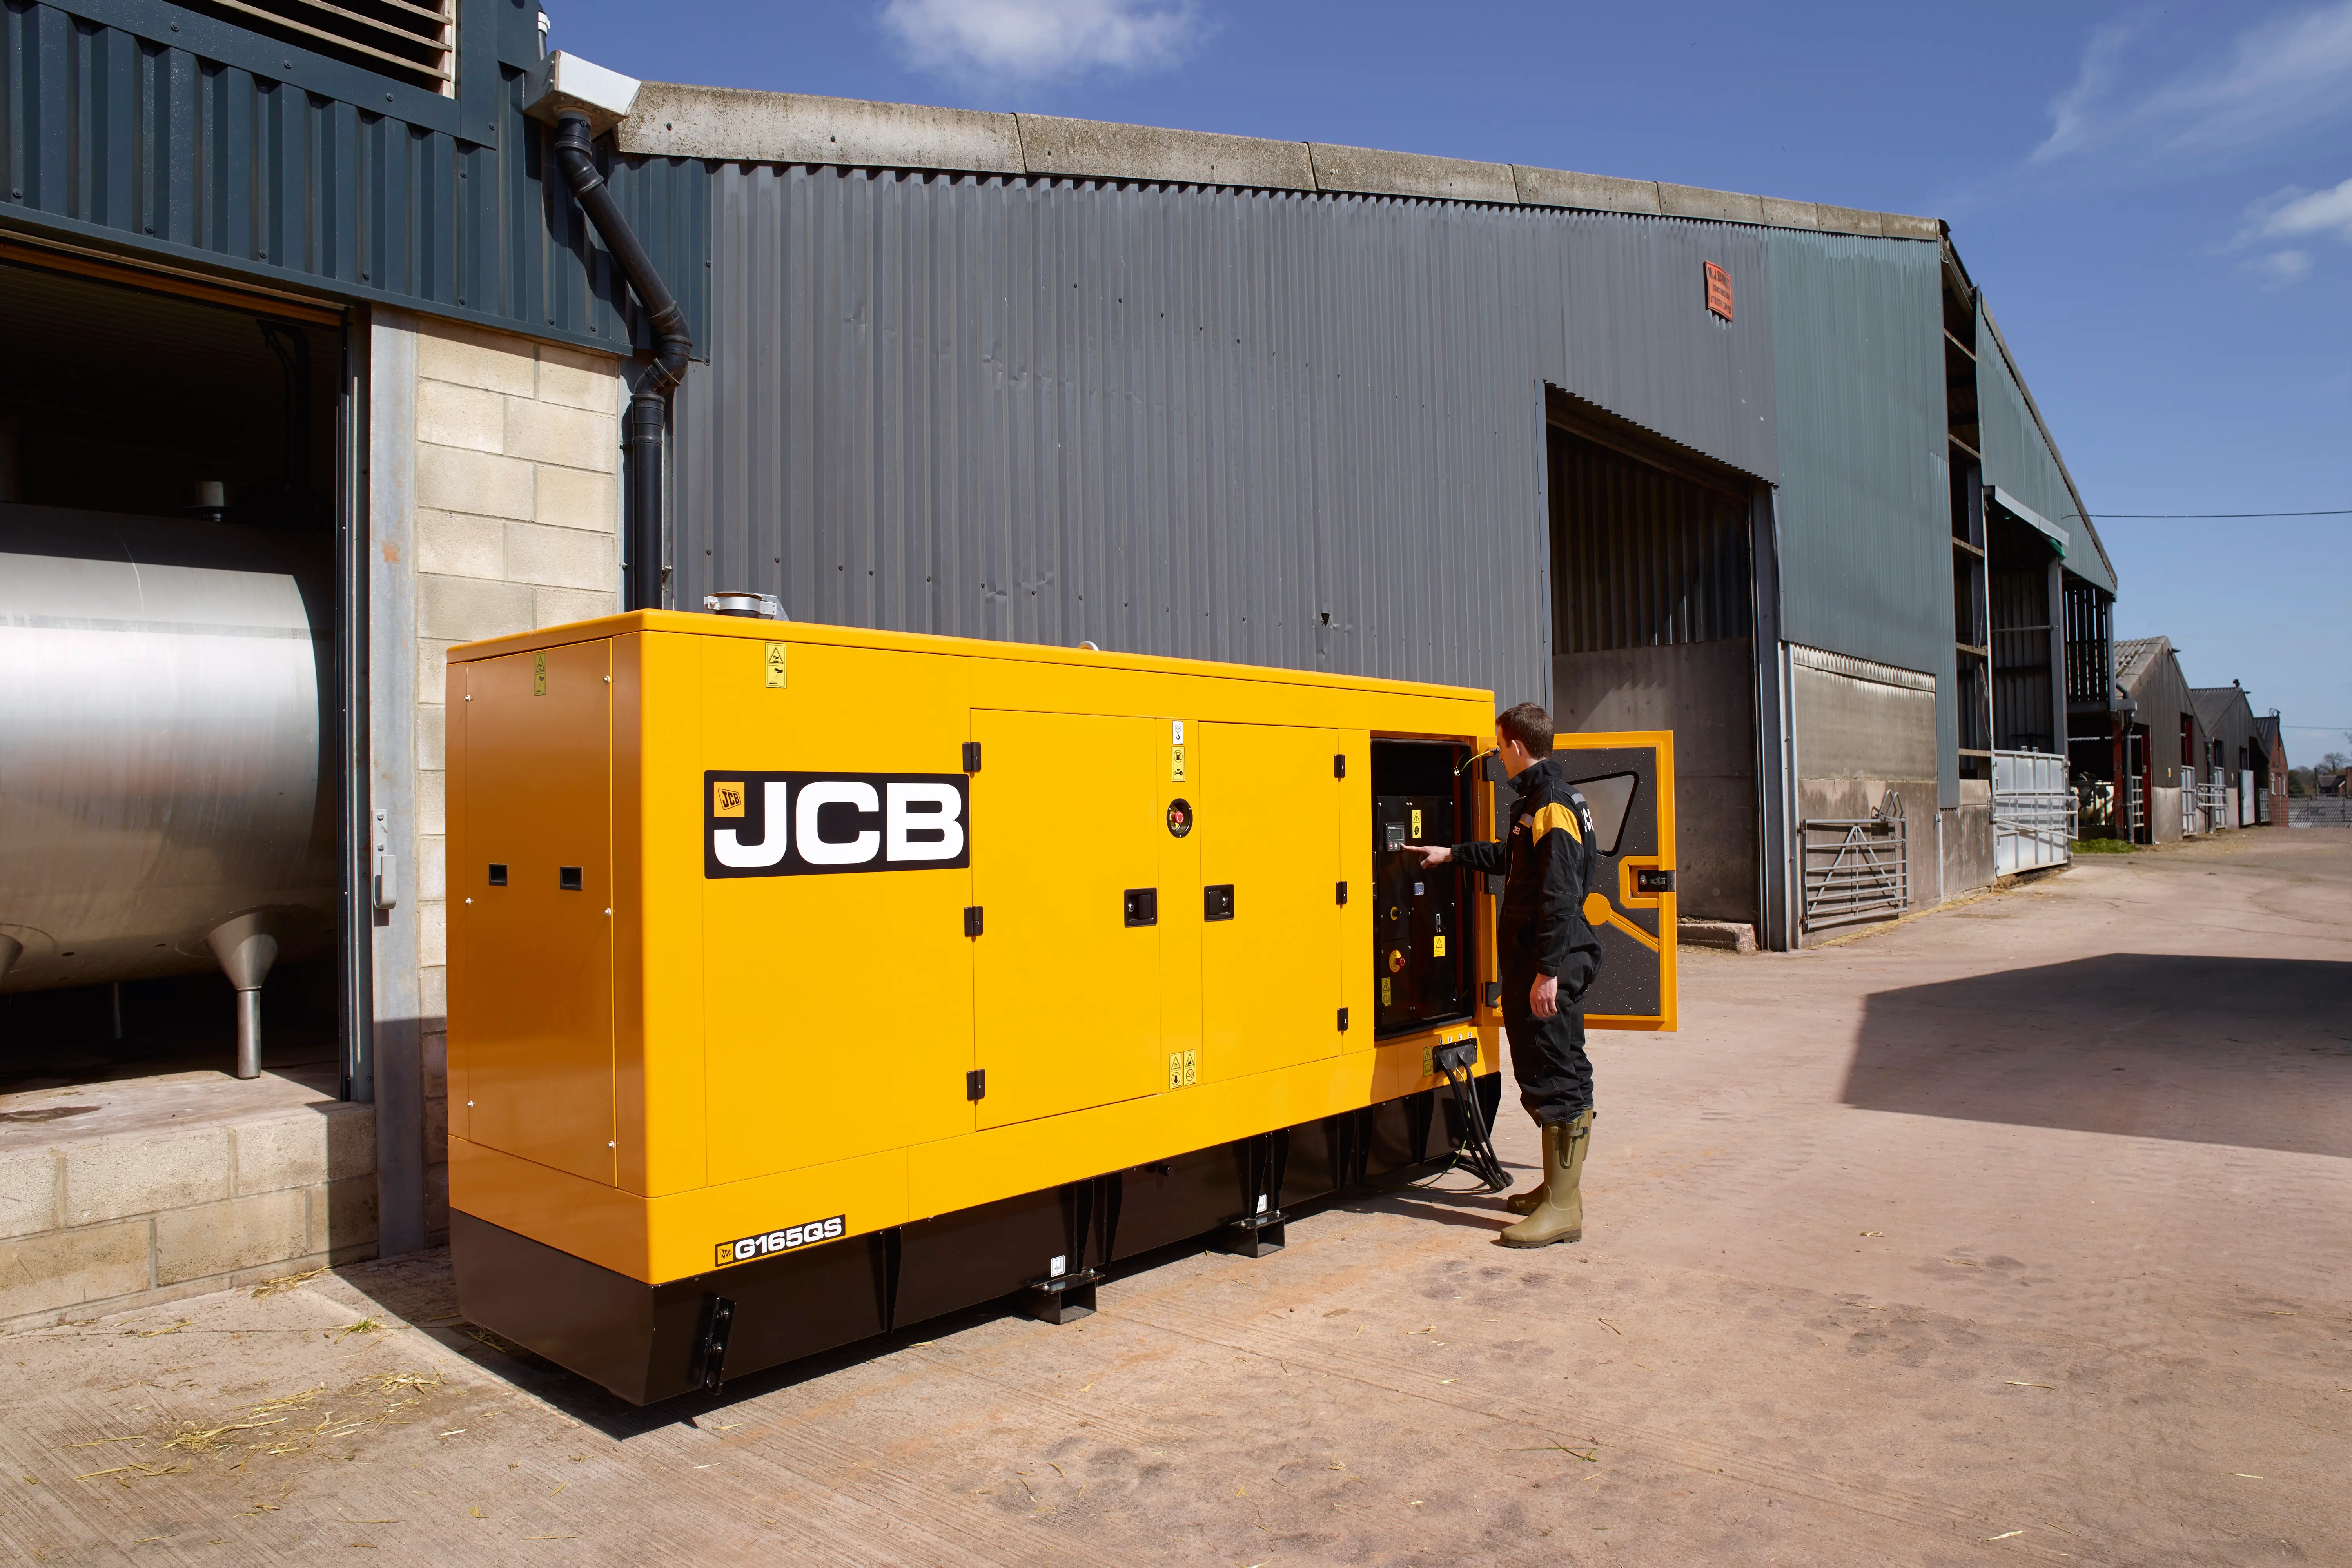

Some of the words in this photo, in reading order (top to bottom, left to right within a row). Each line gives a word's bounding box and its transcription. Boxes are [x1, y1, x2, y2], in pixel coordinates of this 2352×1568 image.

[722, 790, 740, 808] JCB
[714, 781, 964, 867] JCB
[735, 1217, 842, 1259] G165QS
[721, 1249, 731, 1258] JCB
